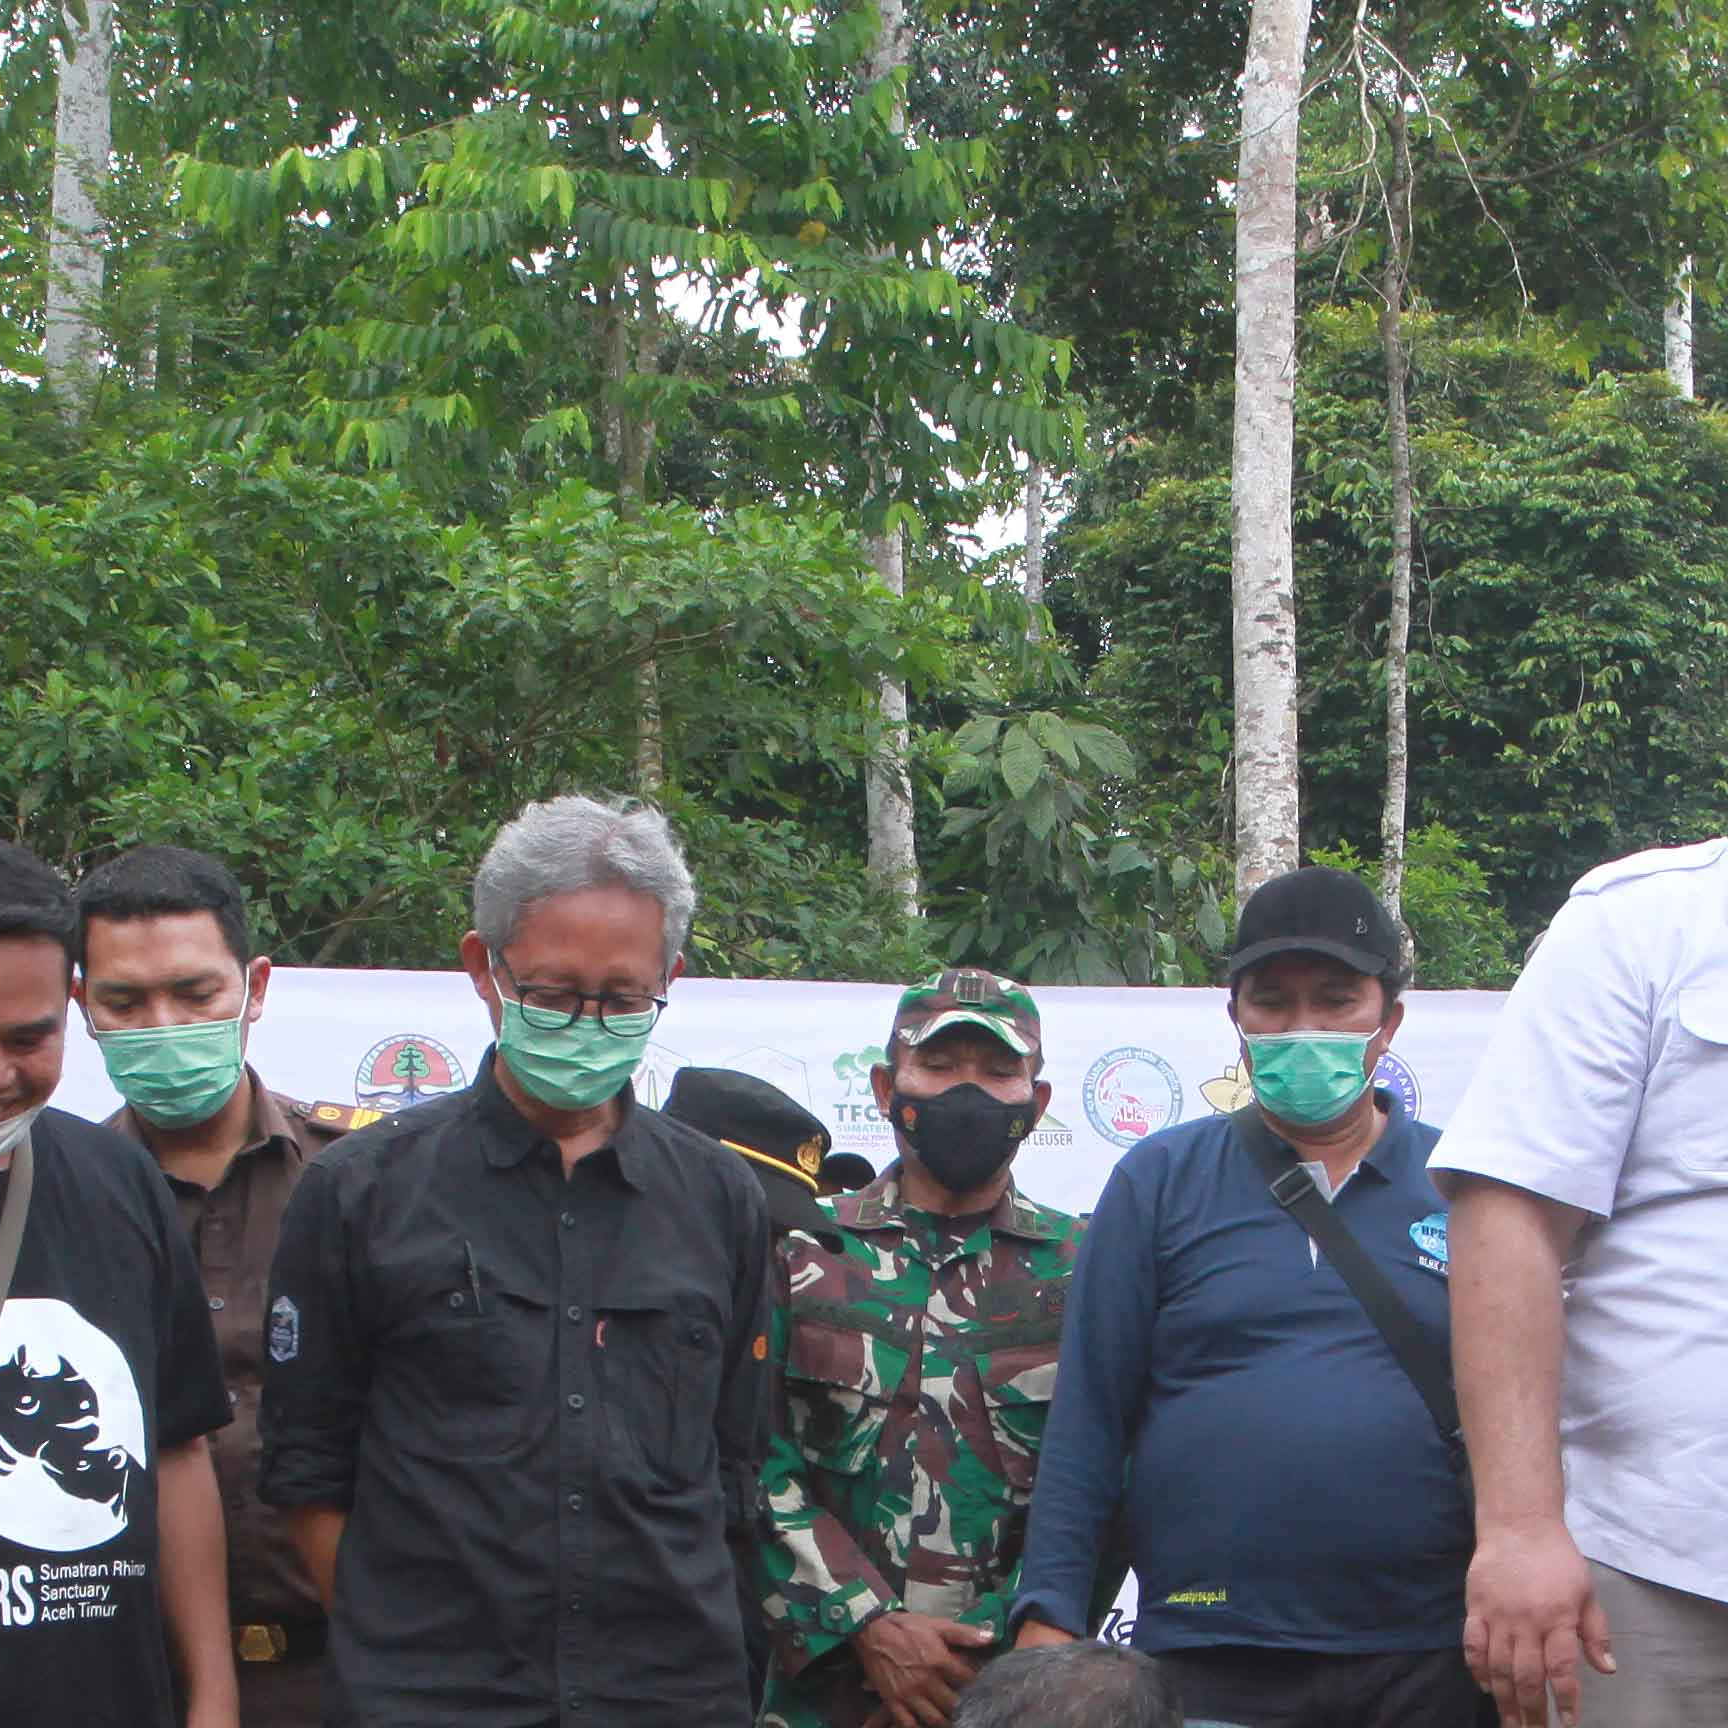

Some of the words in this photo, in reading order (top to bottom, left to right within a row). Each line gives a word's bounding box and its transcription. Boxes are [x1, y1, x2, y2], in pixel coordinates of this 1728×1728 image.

[1377, 1056, 1413, 1112] ERTANIA
[832, 1103, 889, 1122] TFC
[1033, 1132, 1073, 1147] LEUSER
[39, 1563, 109, 1581] Sumatran
[112, 1560, 147, 1577] Rhino
[40, 1584, 110, 1603] Sanctuary
[40, 1605, 75, 1622] Aceh
[78, 1602, 118, 1619] Timur
